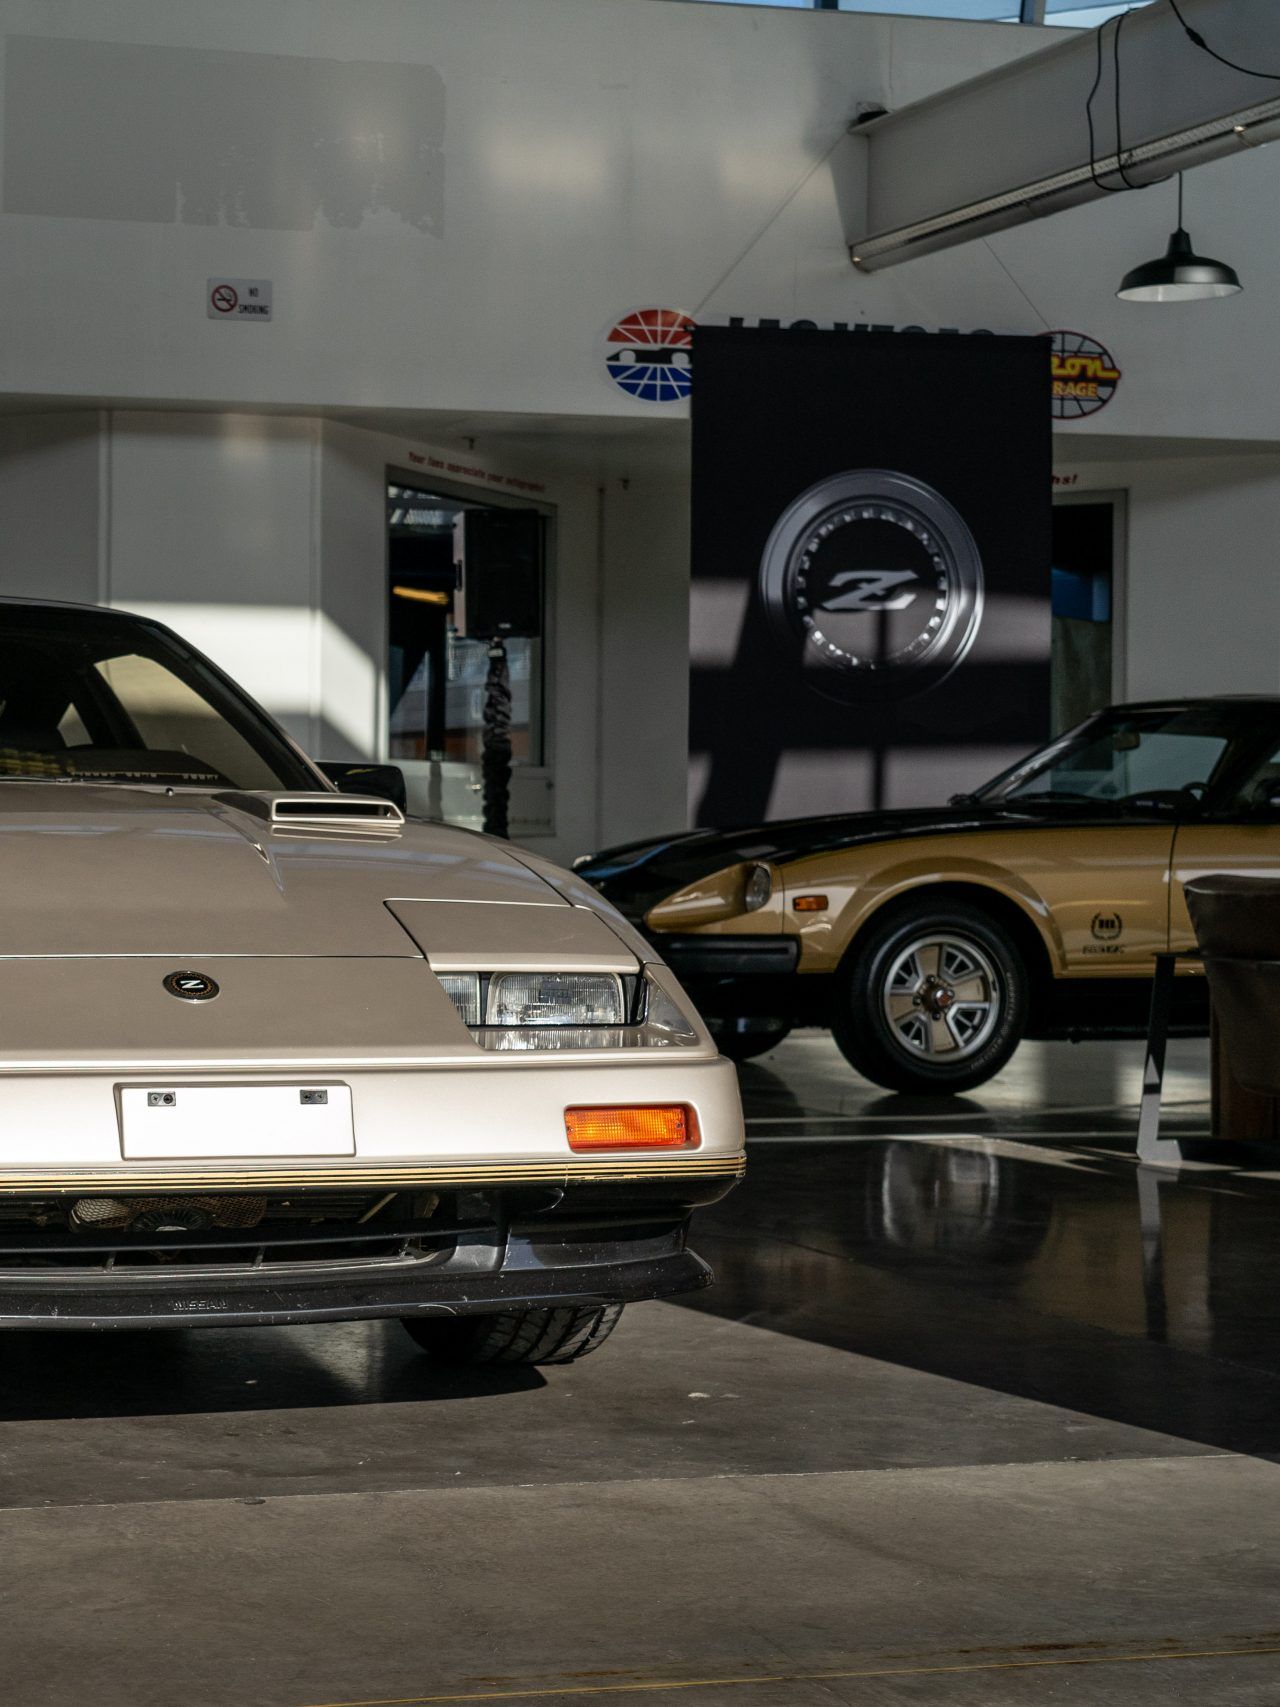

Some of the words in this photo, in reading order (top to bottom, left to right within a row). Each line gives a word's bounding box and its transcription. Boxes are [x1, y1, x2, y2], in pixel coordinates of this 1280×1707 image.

[248, 287, 259, 298] NO
[238, 304, 269, 315] SMOKING
[821, 570, 919, 610] Z
[180, 979, 205, 989] Z
[172, 1299, 228, 1311] NISSAN
